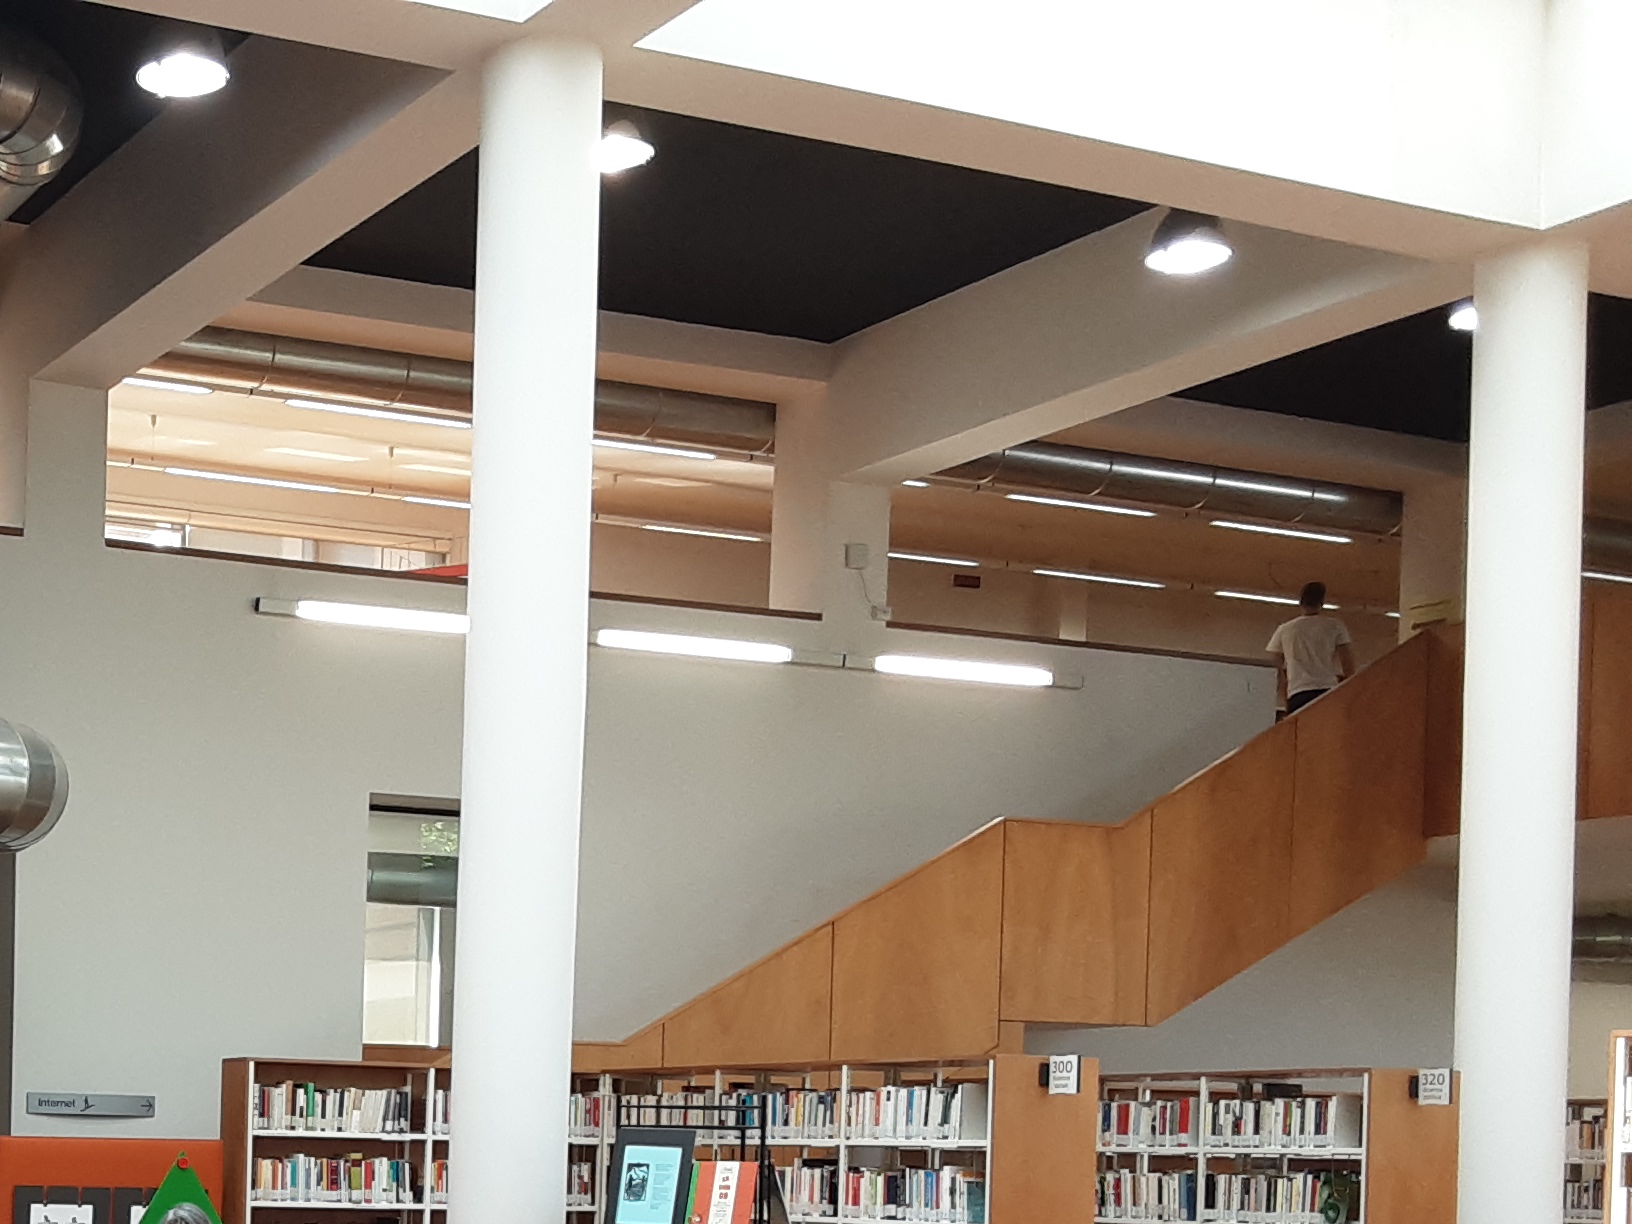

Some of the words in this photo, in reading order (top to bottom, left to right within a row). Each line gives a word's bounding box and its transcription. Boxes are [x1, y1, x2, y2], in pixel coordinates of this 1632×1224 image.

[1052, 1061, 1073, 1073] 300
[1422, 1073, 1445, 1086] 320
[38, 1098, 76, 1108] Internet
